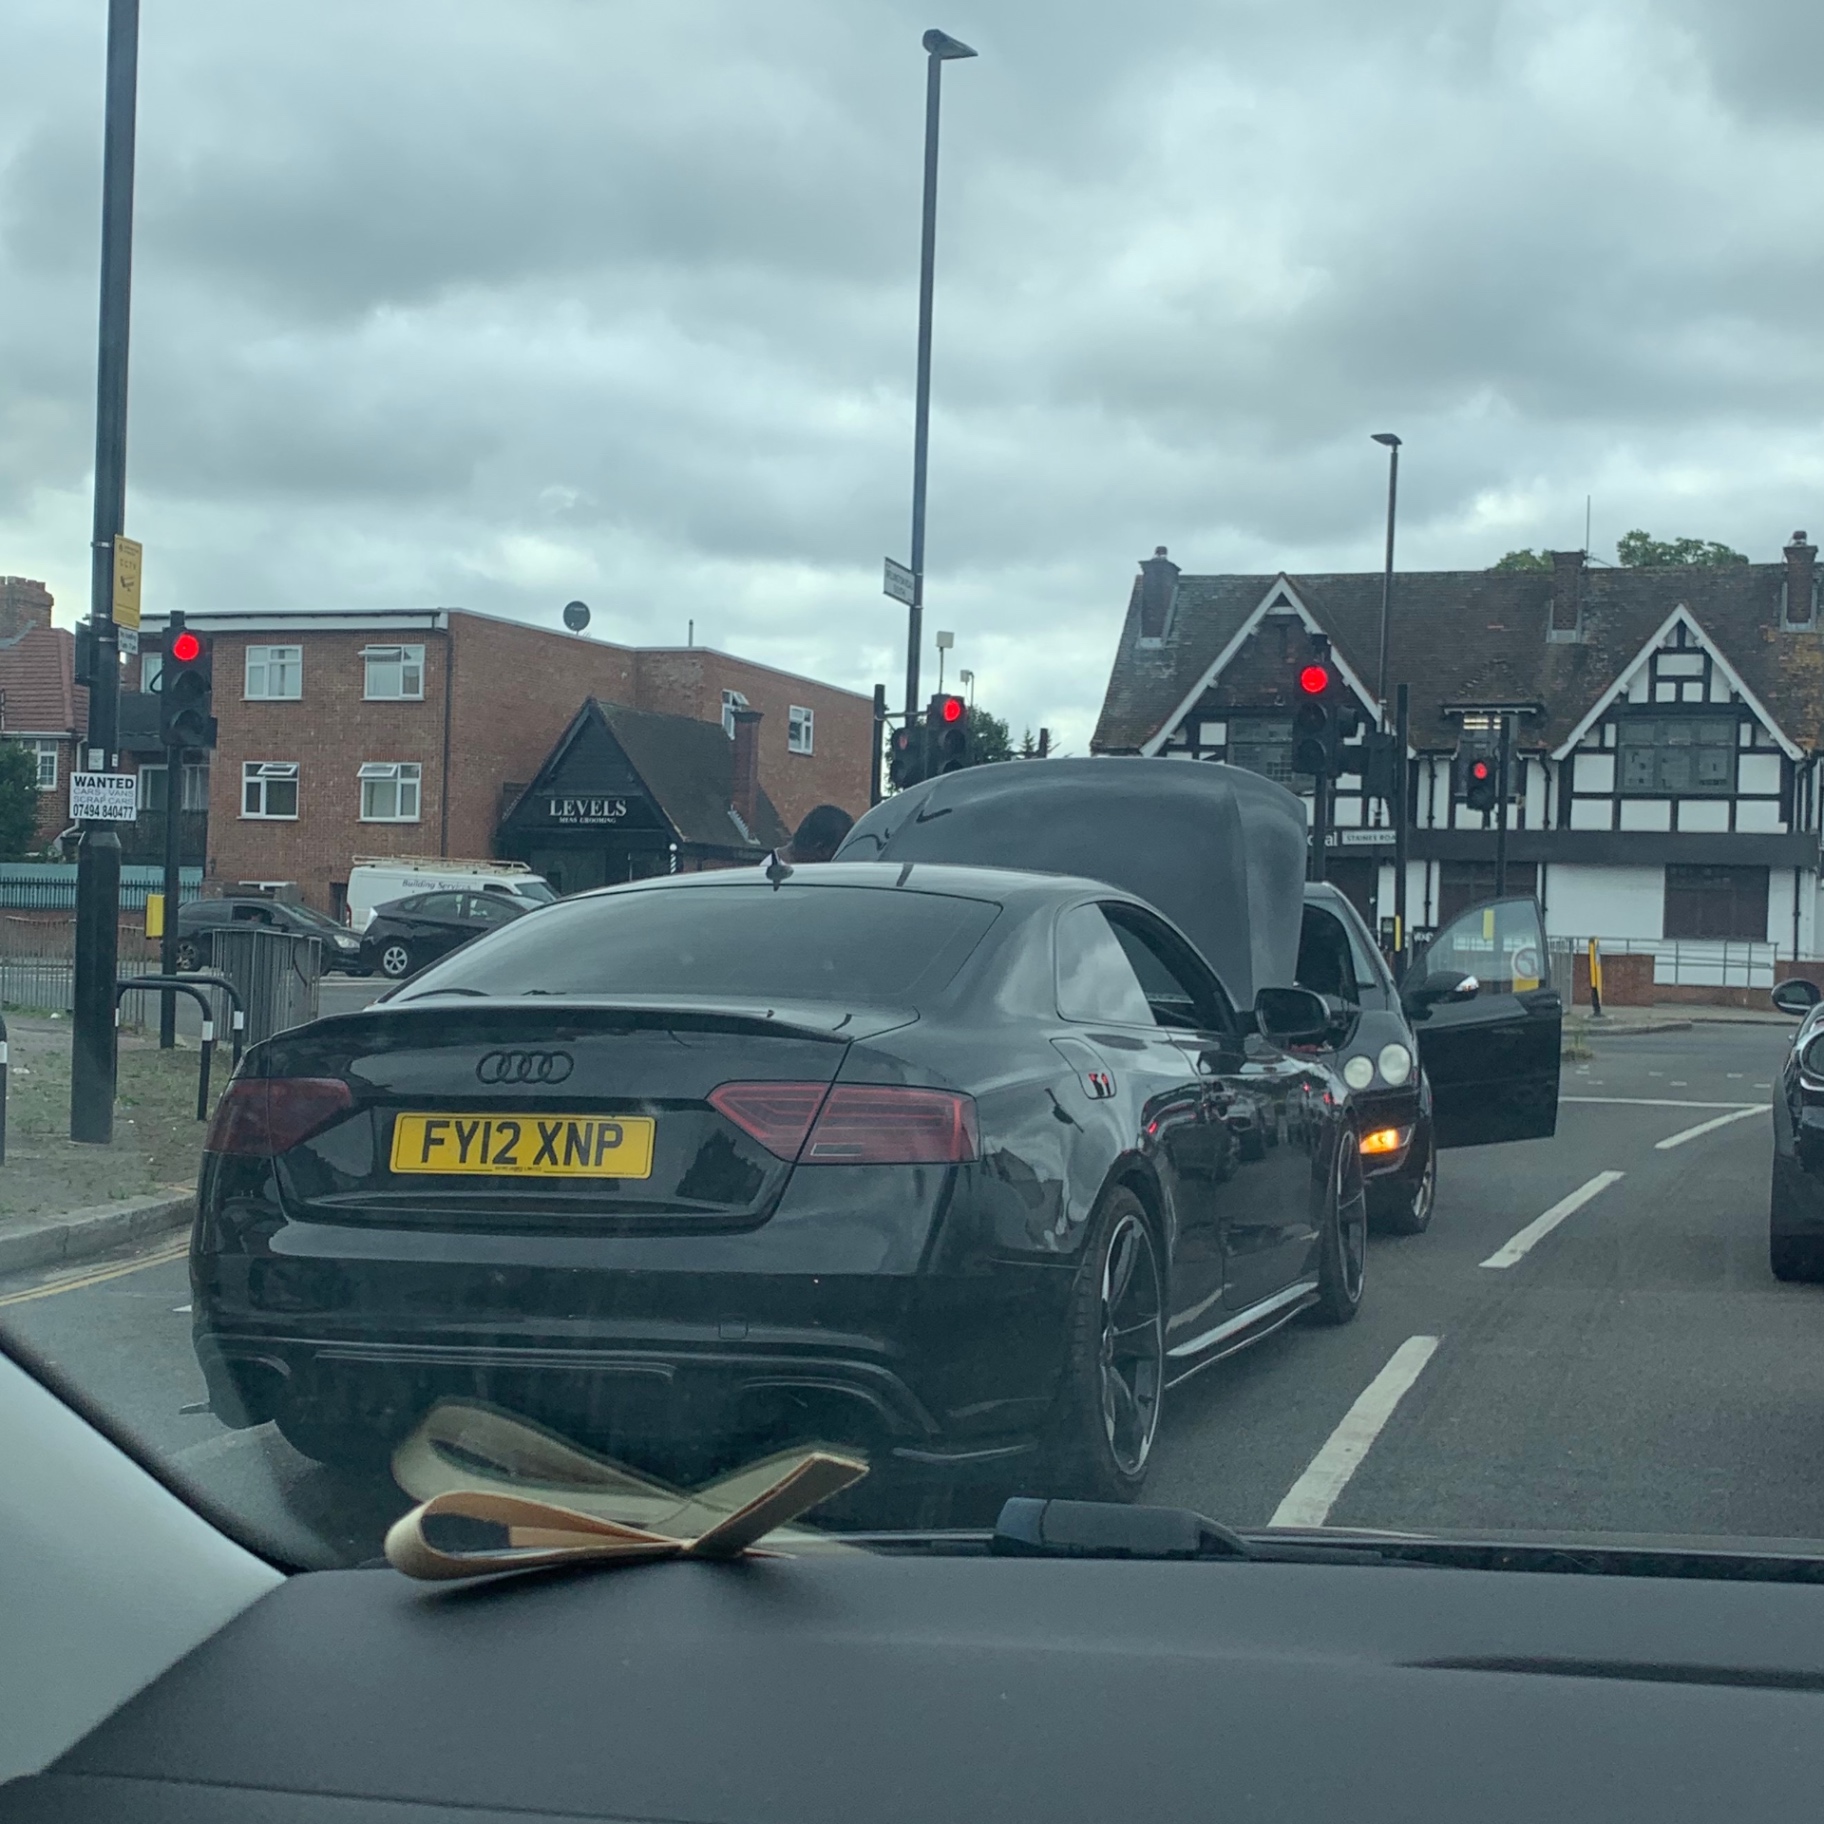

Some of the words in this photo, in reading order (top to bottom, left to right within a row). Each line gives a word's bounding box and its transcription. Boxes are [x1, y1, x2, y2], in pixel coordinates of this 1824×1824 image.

[74, 776, 134, 789] WANTED
[73, 788, 101, 796] CARS
[108, 790, 134, 798] VANS
[73, 795, 105, 804] SCRAP
[108, 797, 134, 806] CARS
[73, 803, 100, 817] 07494
[102, 805, 134, 819] 840477
[549, 800, 627, 816] LEVELS
[402, 879, 435, 890] Building
[421, 1120, 522, 1165] FY12
[532, 1120, 624, 1167] XNP
